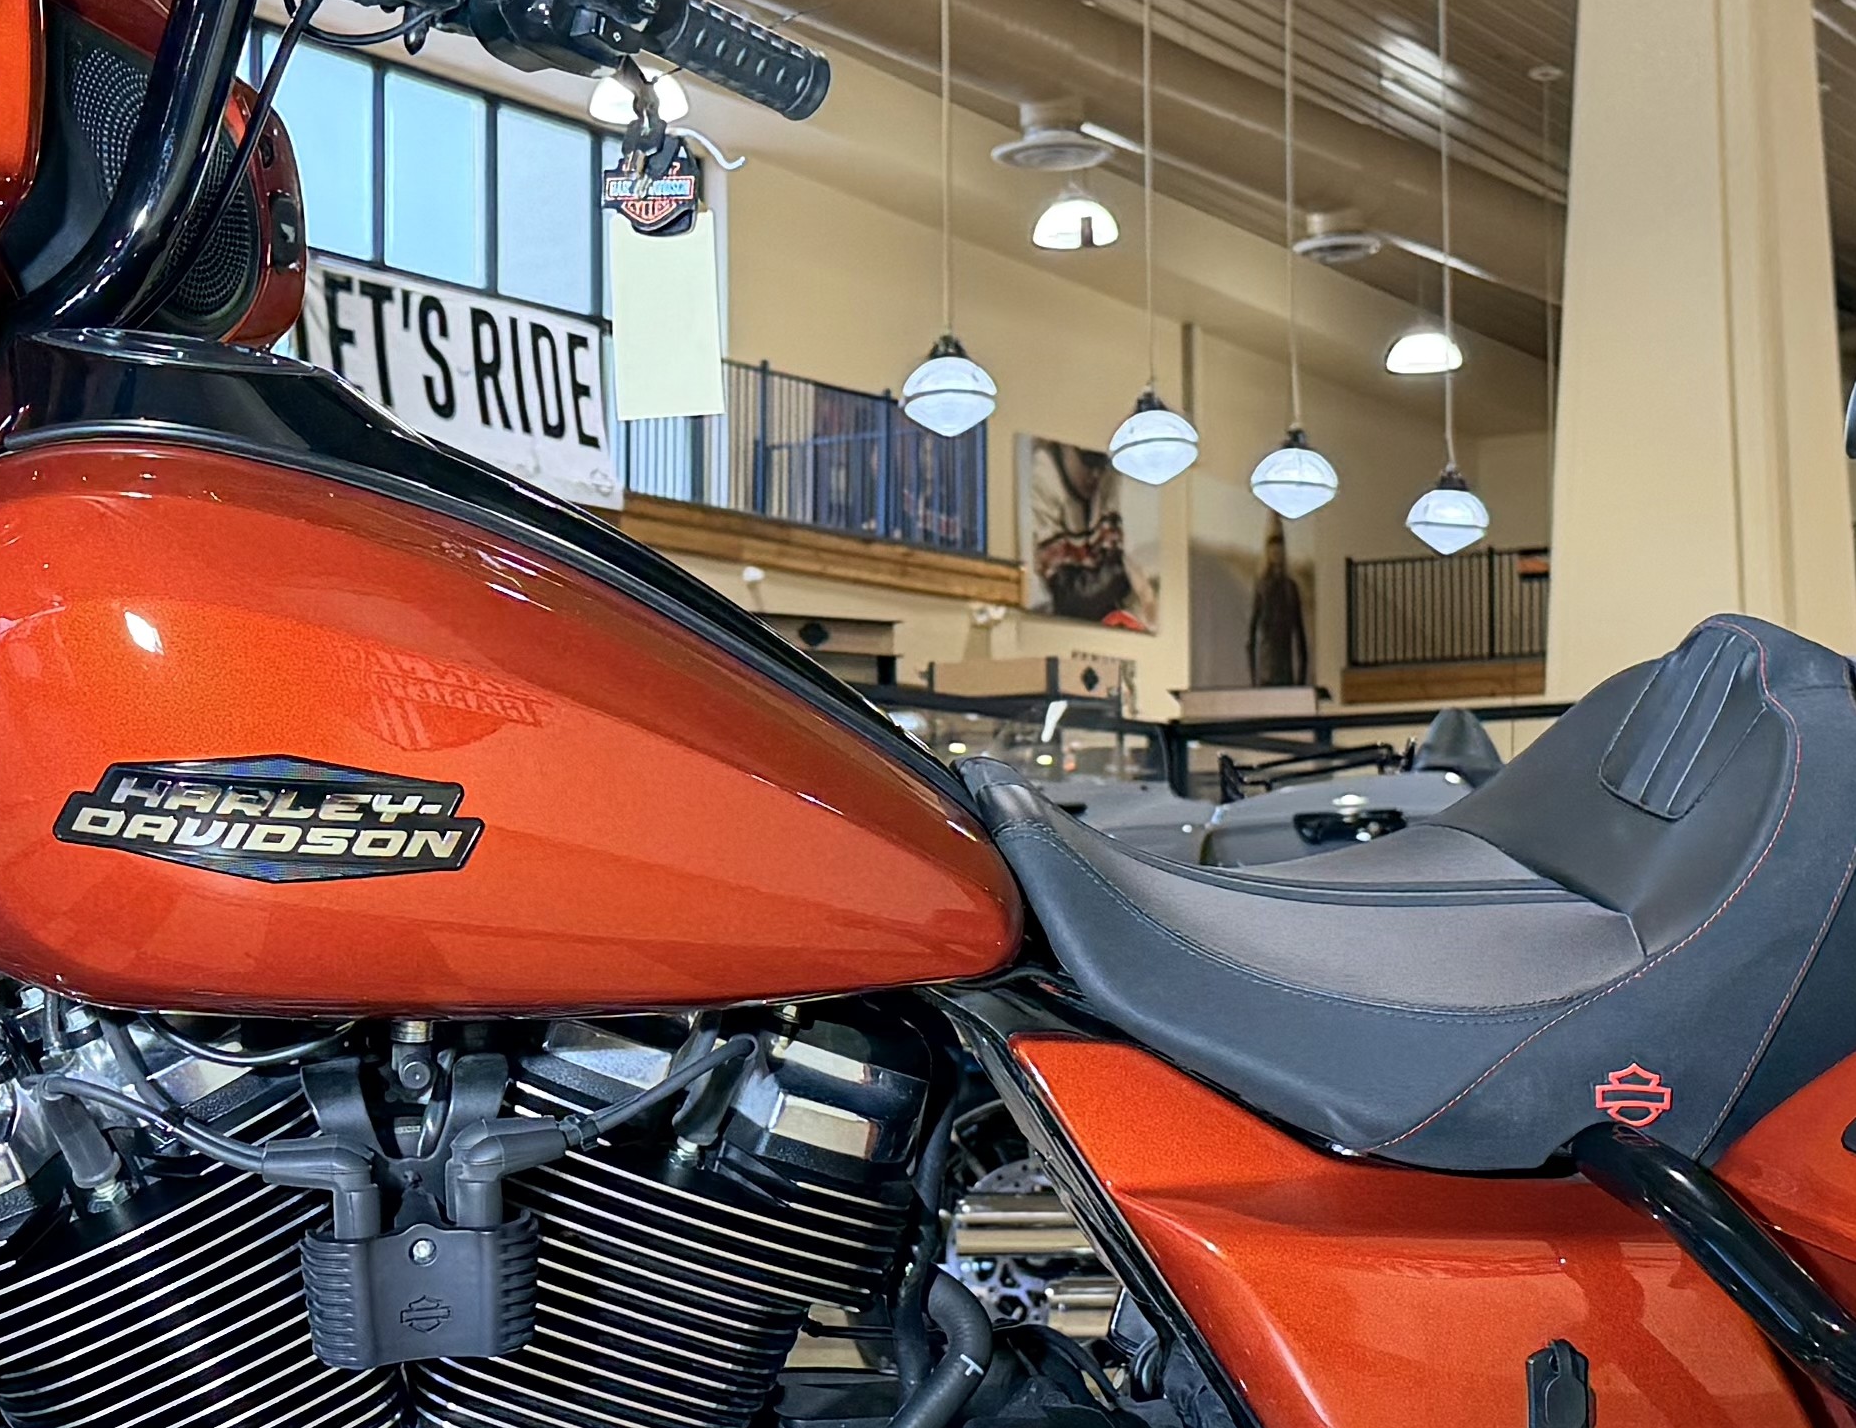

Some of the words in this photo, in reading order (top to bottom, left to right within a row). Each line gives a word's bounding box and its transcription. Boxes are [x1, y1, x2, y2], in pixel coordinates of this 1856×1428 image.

[469, 305, 602, 450] RIDE
[110, 775, 443, 823] HARLEY-
[71, 807, 463, 859] DAVIDSON
